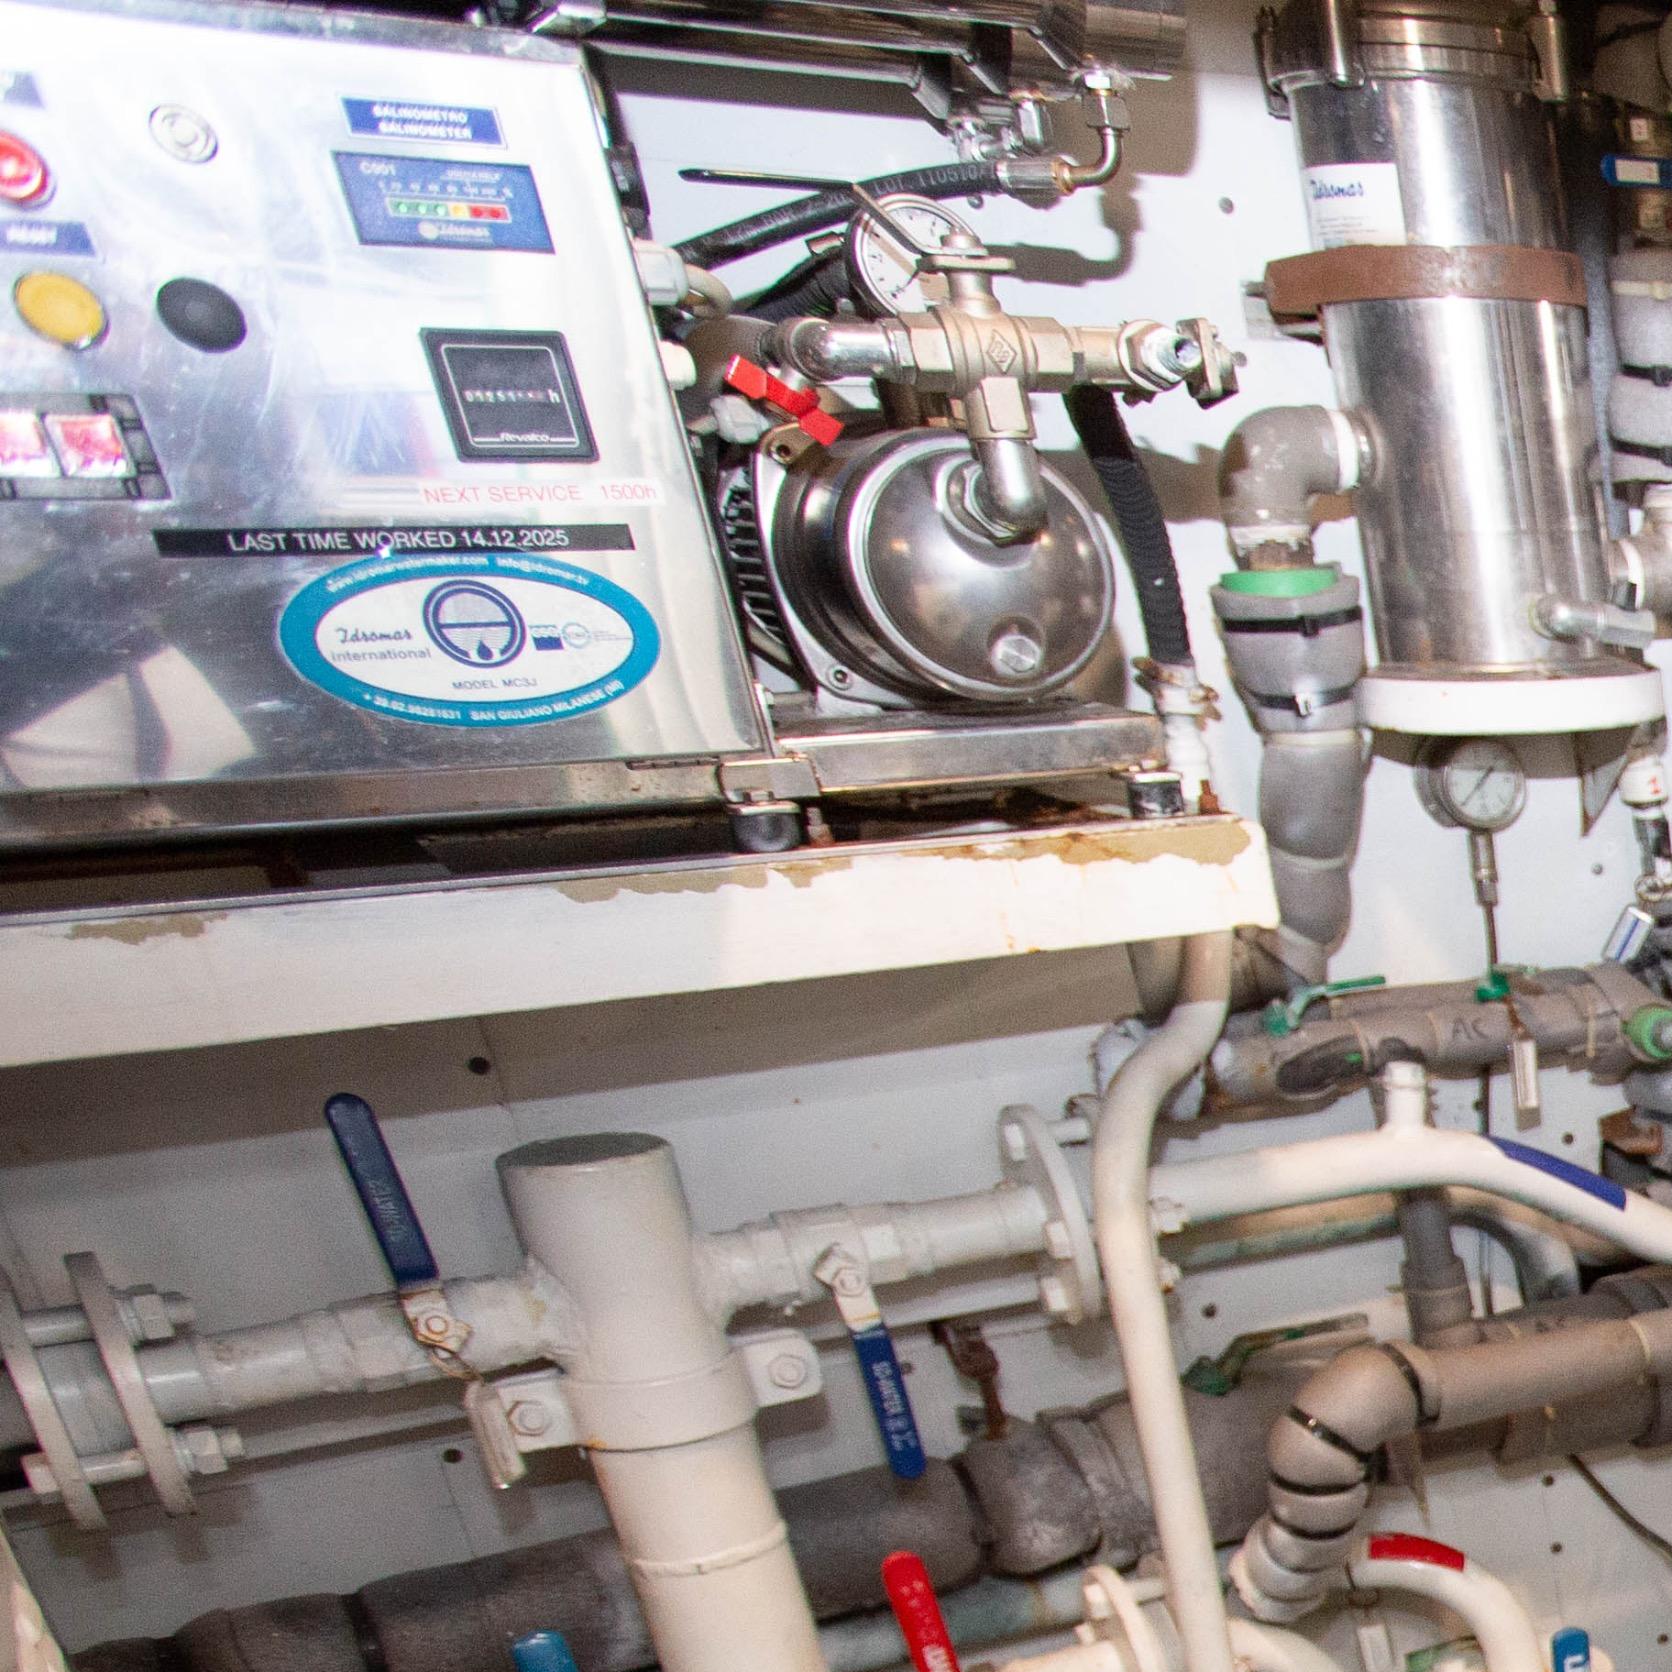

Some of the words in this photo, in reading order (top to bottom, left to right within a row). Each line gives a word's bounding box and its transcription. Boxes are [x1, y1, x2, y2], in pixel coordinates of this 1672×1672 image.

[422, 486, 482, 505] NEXT
[488, 483, 582, 504] SERVICE
[600, 482, 658, 502] 1500h
[226, 533, 287, 552] LAST
[291, 532, 352, 551] TIME
[352, 530, 458, 550] WORKED
[460, 529, 571, 549] 14.12.2025
[452, 678, 498, 691] MODEL
